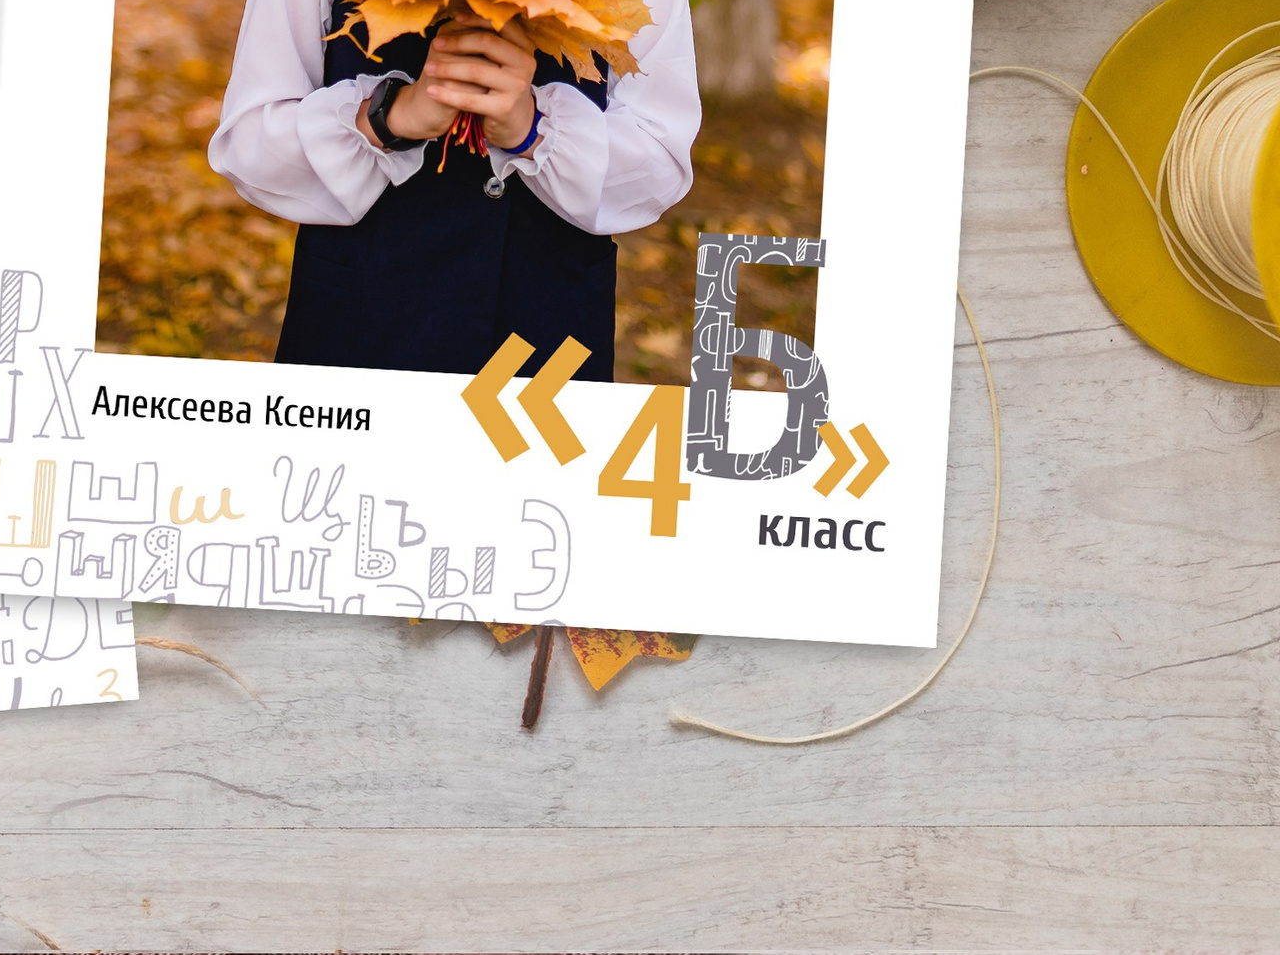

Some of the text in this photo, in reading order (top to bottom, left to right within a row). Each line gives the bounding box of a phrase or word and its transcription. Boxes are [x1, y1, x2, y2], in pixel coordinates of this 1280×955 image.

[91, 385, 372, 433] Алексеева Ксения
[759, 514, 887, 553] класс
